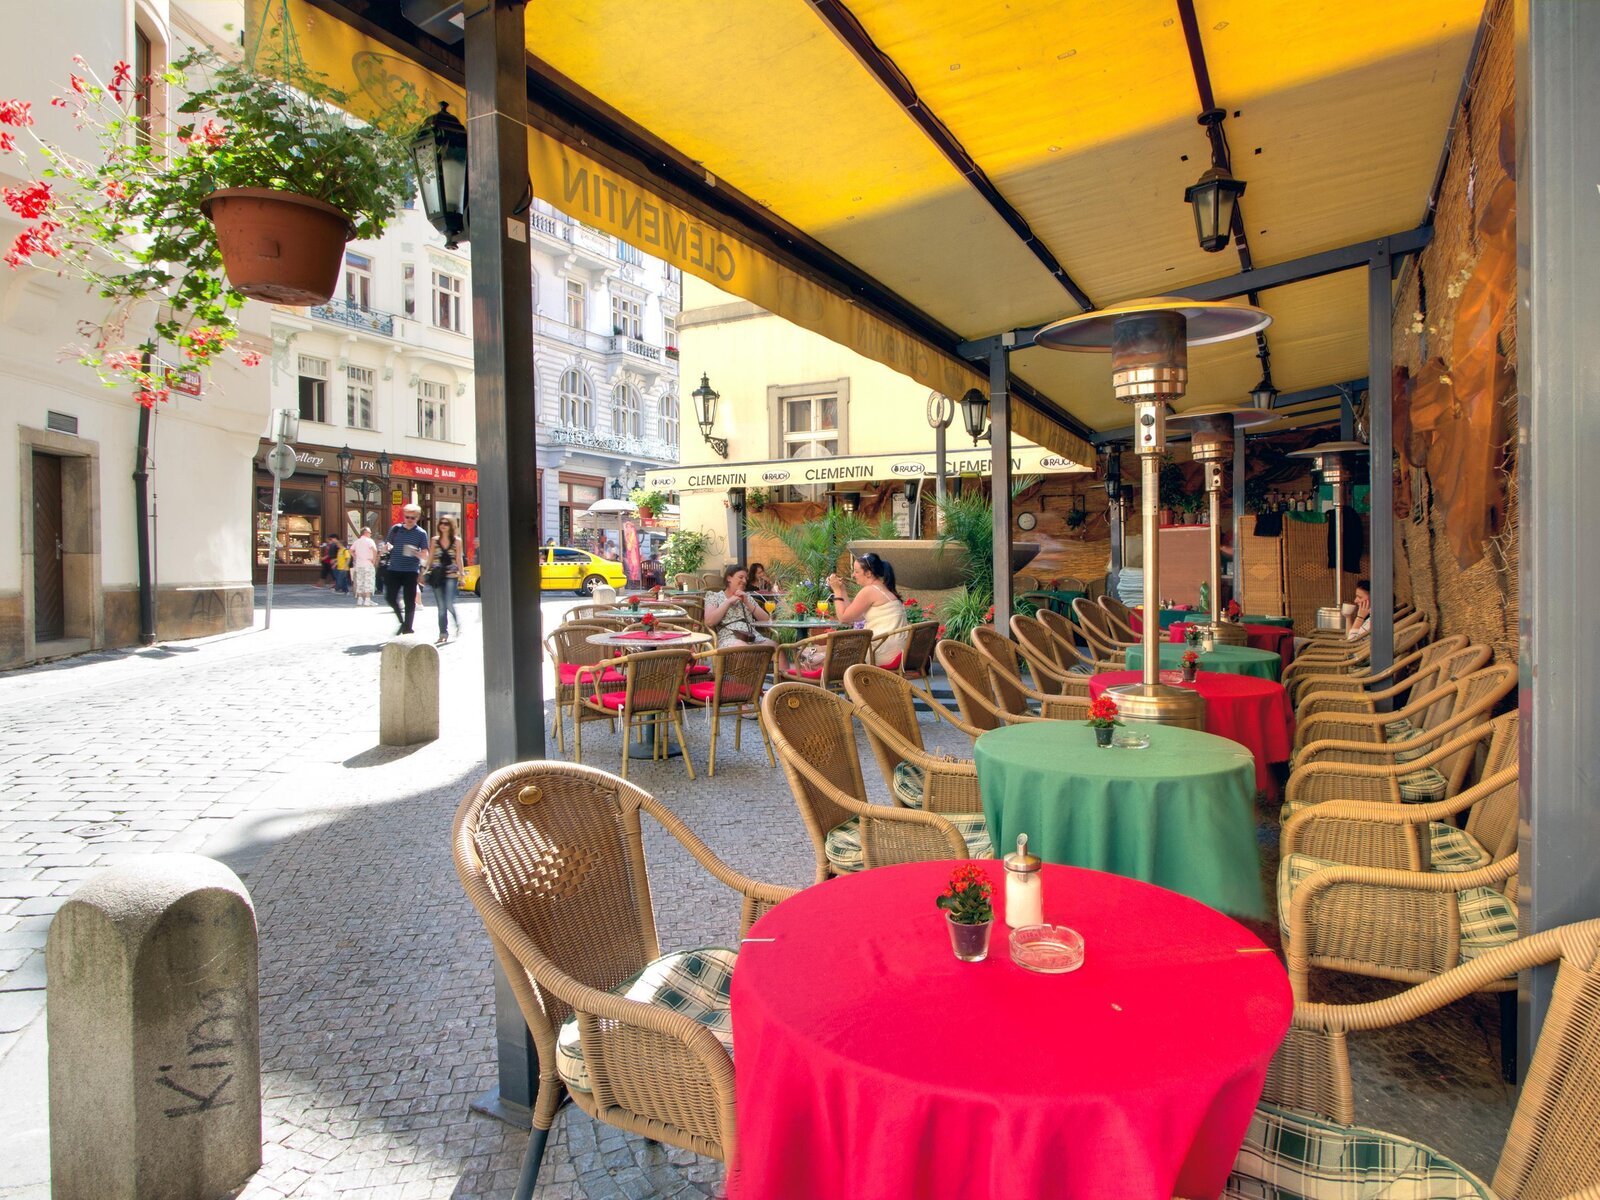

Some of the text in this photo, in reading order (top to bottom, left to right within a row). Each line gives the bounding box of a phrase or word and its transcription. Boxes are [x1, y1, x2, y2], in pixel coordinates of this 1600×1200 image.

[360, 460, 374, 471] 178
[688, 473, 747, 487] CLEMENTIN
[768, 472, 788, 480] RAUCH
[805, 465, 874, 481] CLEMENTIN
[899, 465, 922, 473] RAUCH
[945, 458, 1021, 473] CLEMEN
